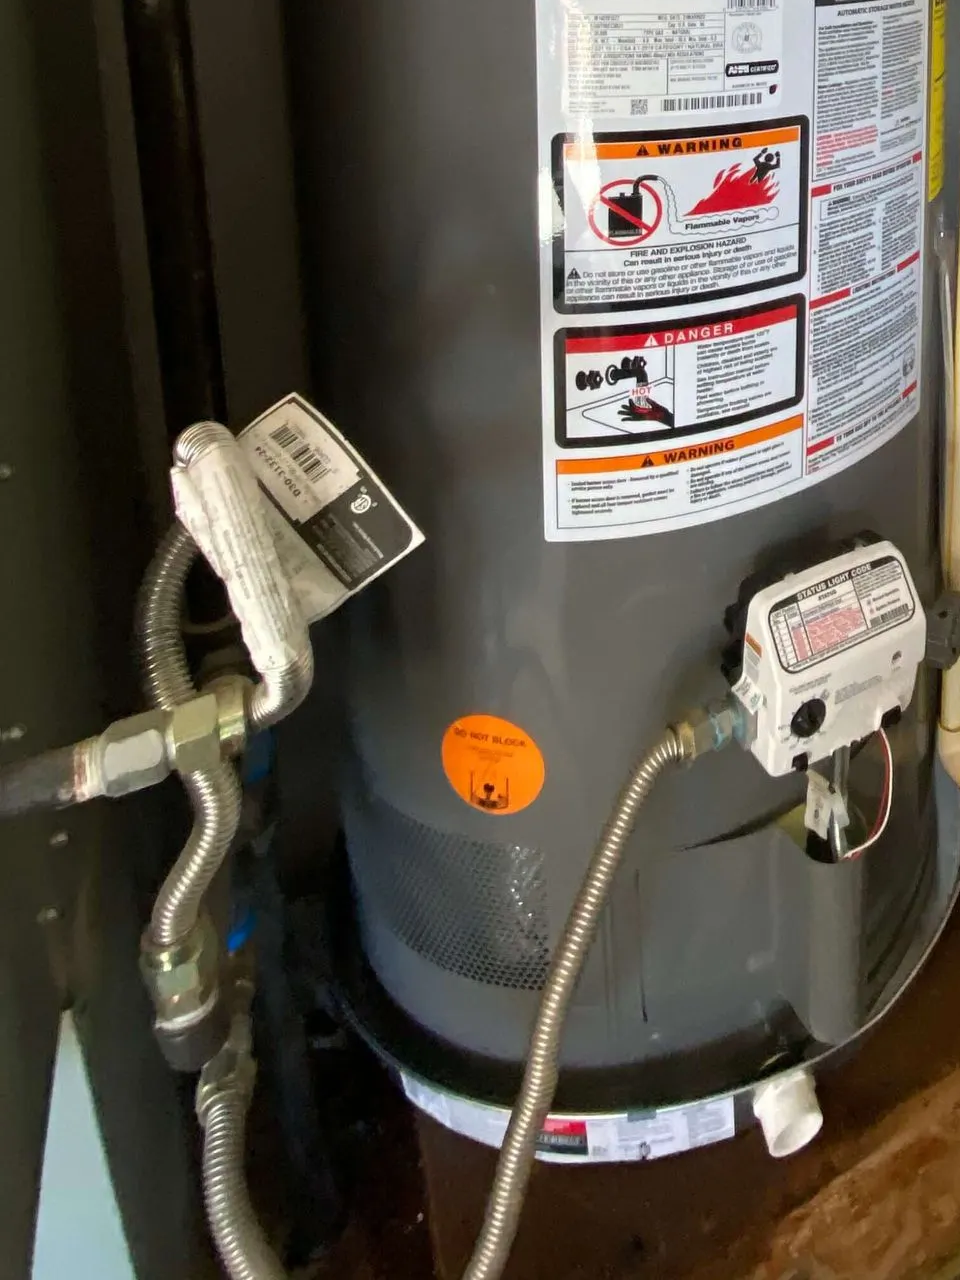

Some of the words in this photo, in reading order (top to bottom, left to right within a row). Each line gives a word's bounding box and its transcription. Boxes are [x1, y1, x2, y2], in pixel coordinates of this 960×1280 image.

[838, 8, 867, 16] AUTOMATIC
[657, 137, 742, 155] WARNING
[685, 218, 731, 231] Flammable
[733, 214, 760, 225] Vapors
[630, 249, 648, 257] FIRE
[670, 242, 714, 253] EXPLOSION
[716, 237, 746, 247] HAZARD
[674, 252, 700, 262] serious
[702, 250, 722, 259] injury
[733, 244, 752, 253] death
[651, 266, 679, 275] gasoline
[709, 256, 741, 266] flammable
[644, 276, 657, 284] any
[664, 322, 734, 344] DANGER
[632, 386, 651, 395] HOT
[664, 440, 734, 464] WARNING
[797, 583, 826, 600] STATUS
[827, 574, 849, 587] LIGHT
[851, 563, 872, 576] CODE
[470, 731, 489, 741] NOT
